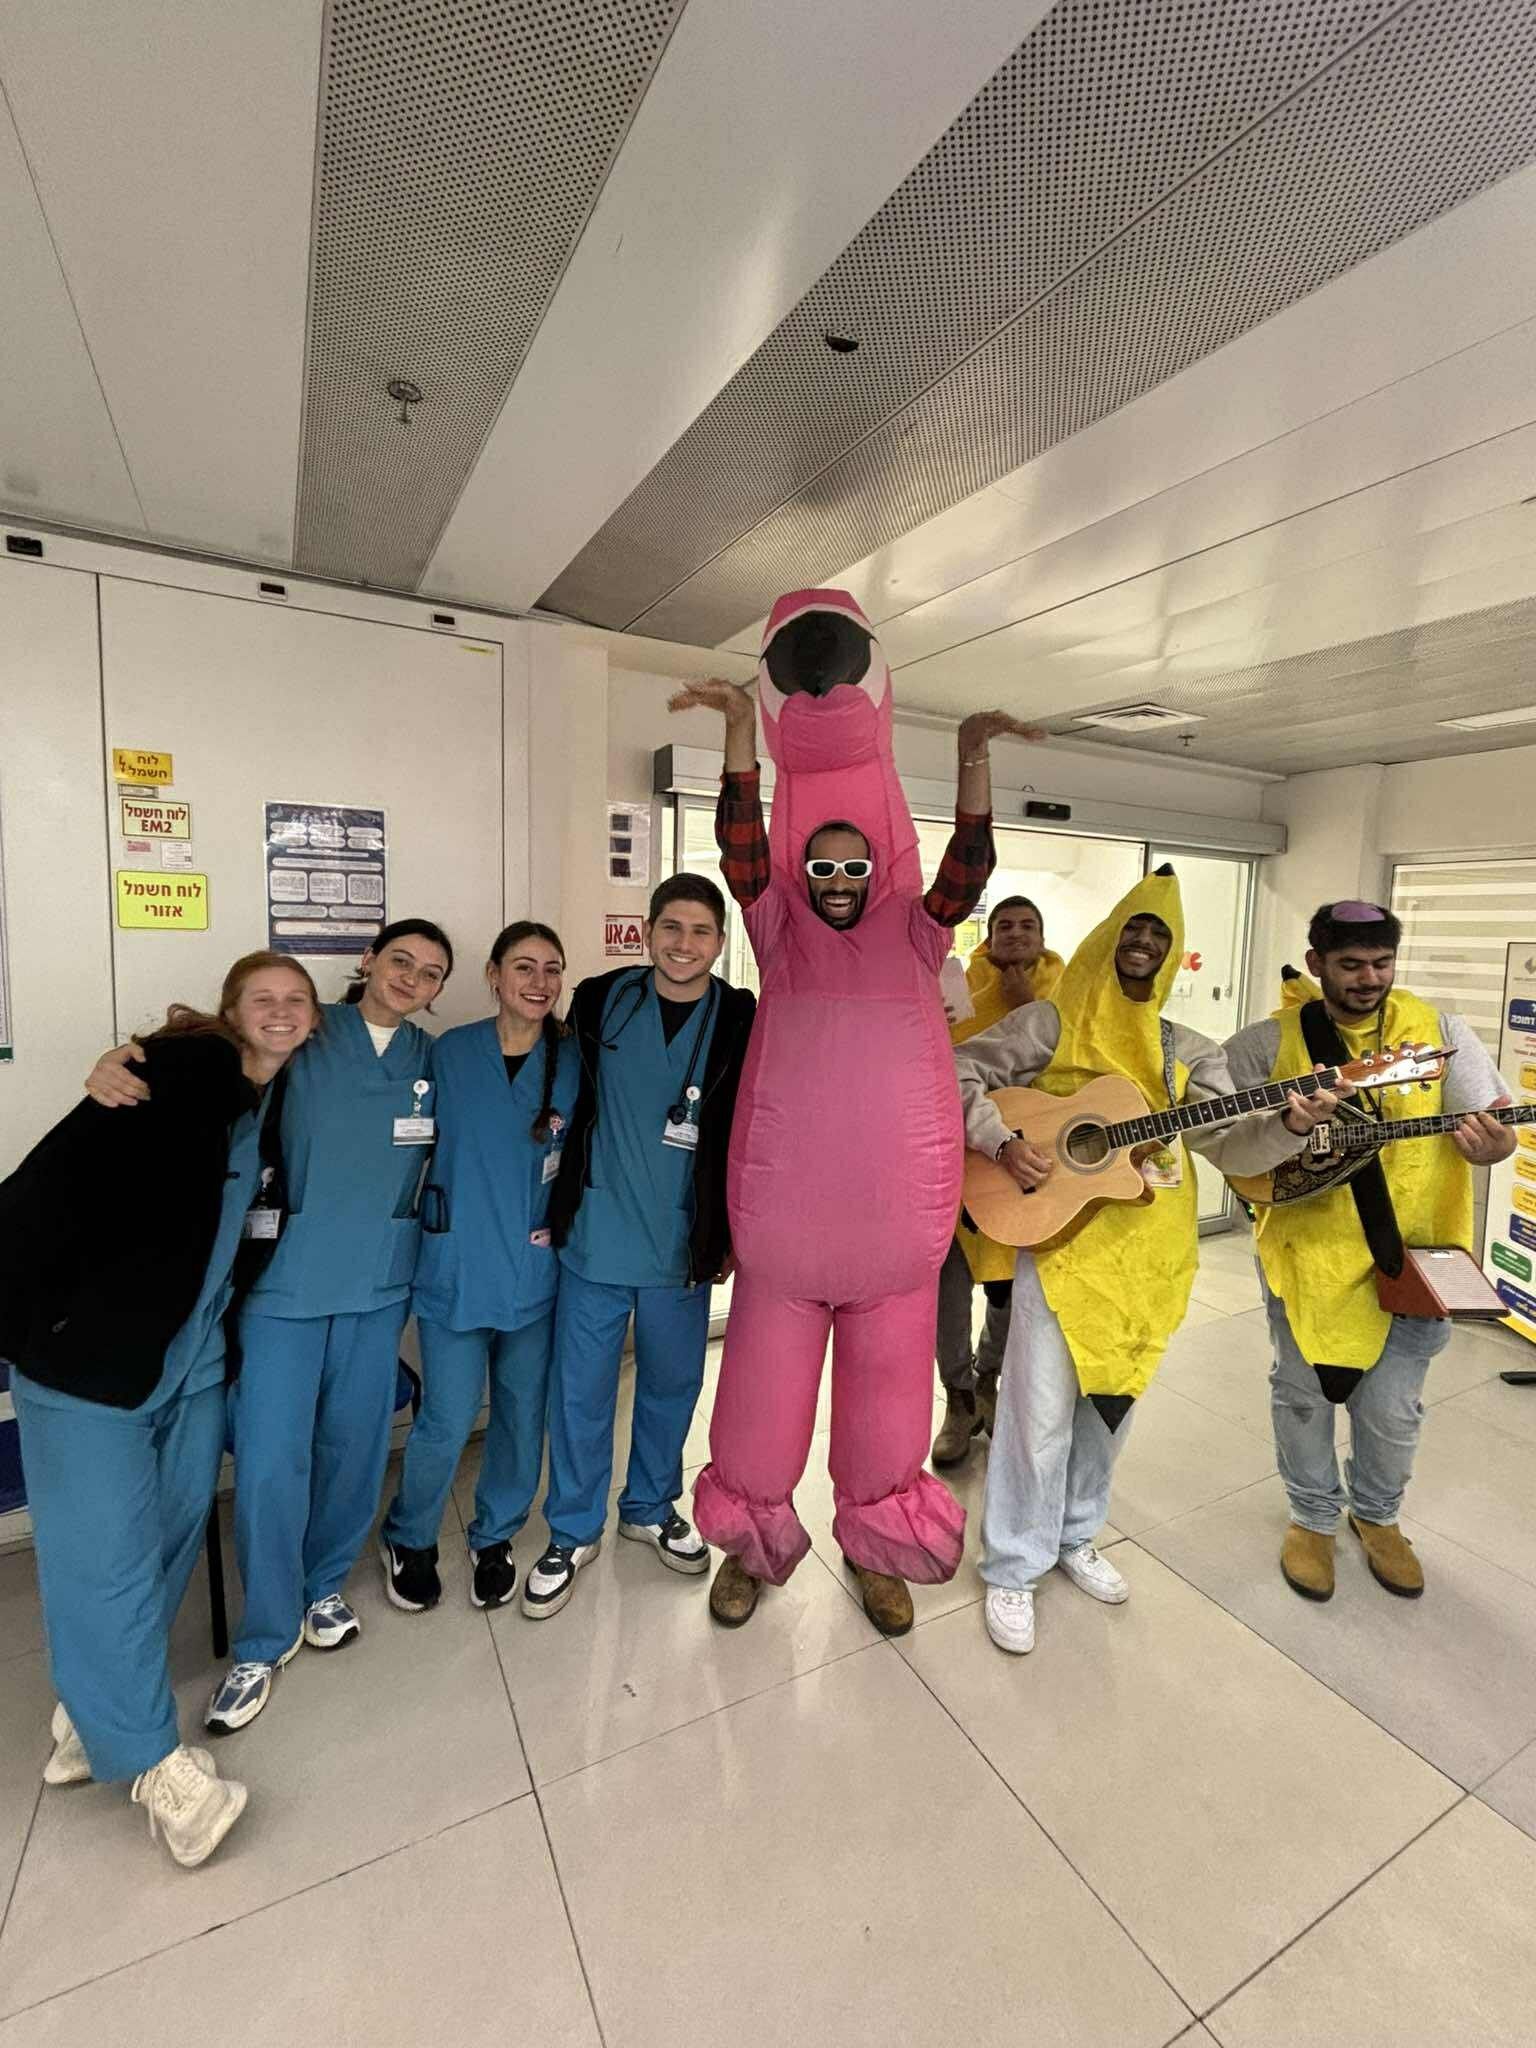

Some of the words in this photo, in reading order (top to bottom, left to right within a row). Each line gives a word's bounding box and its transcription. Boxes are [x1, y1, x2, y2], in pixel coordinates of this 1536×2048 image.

[137, 754, 159, 766] לוח
[127, 766, 168, 779] חשמל
[125, 802, 163, 819] חשמל
[167, 807, 187, 820] לוח
[141, 820, 173, 833] EM2
[123, 879, 172, 897] חשמל
[176, 883, 202, 898] לוח
[144, 904, 183, 917] אזורי
